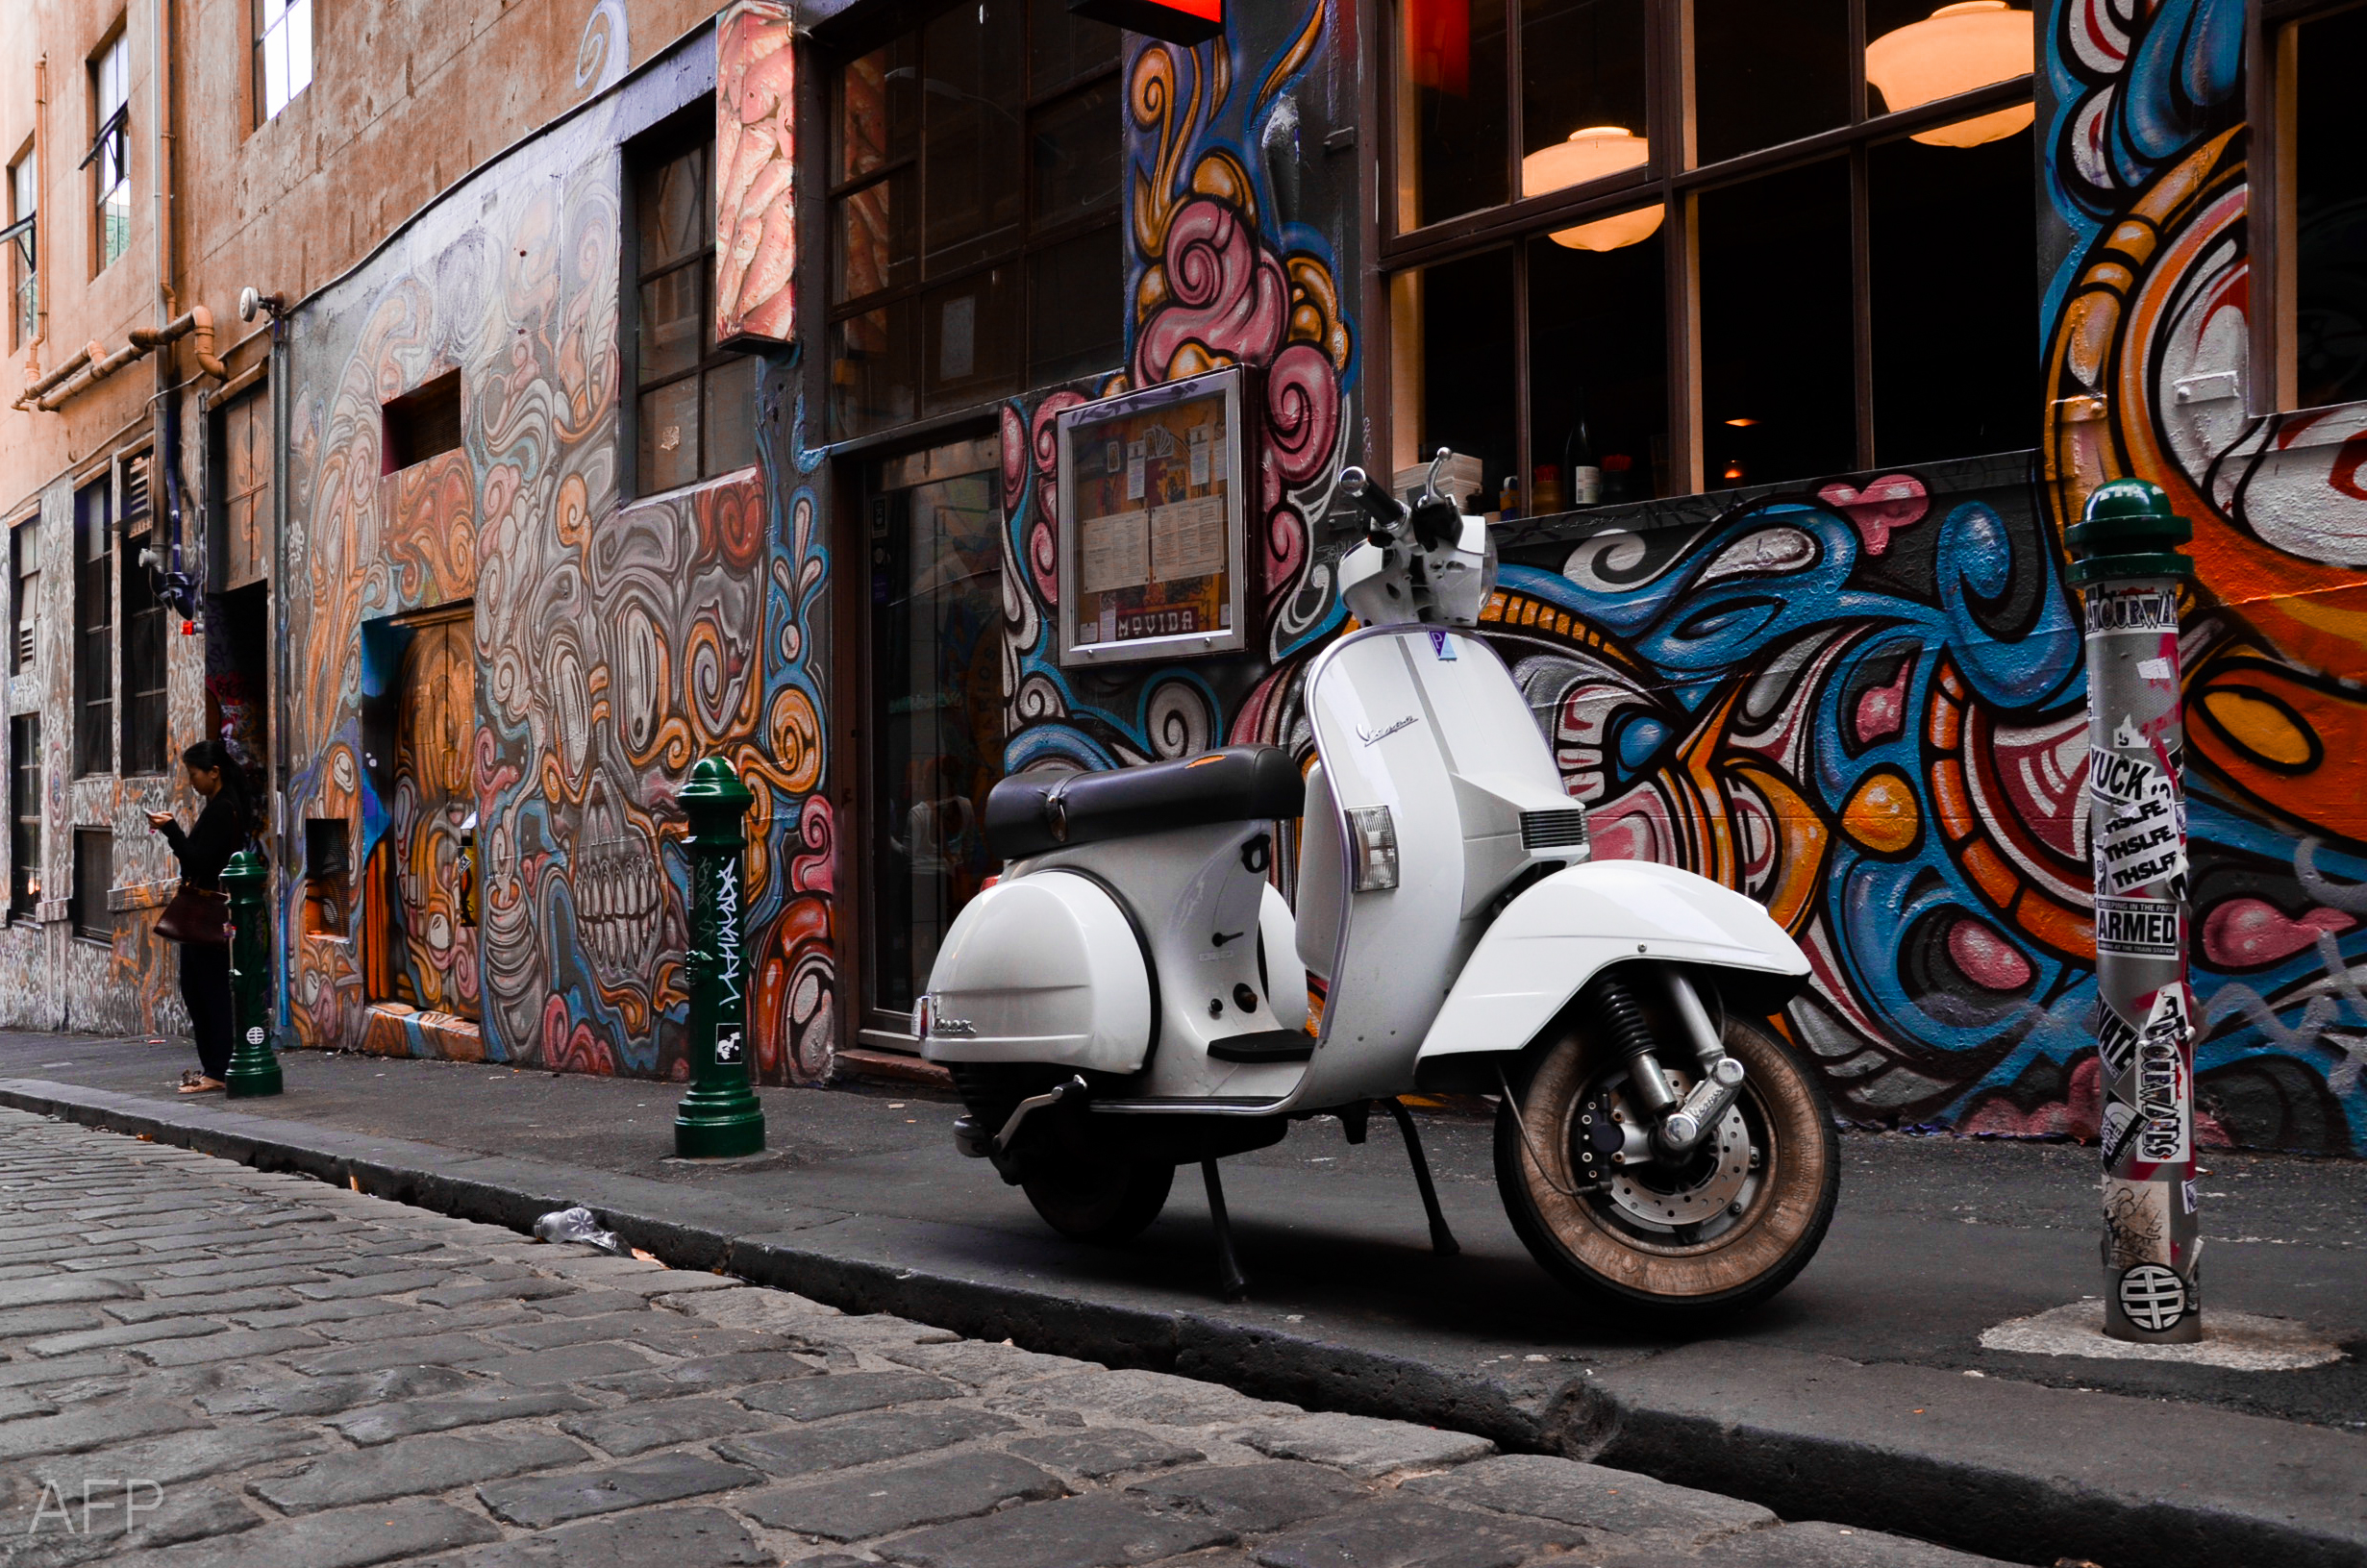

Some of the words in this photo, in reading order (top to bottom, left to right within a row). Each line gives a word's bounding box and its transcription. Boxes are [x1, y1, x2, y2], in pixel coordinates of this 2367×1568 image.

[1118, 610, 1193, 637] MOVIDA
[1357, 715, 1418, 747] Vespa
[2091, 747, 2152, 801] YUCK
[2098, 910, 2176, 943] ARMED
[2105, 1126, 2125, 1157] LINE
